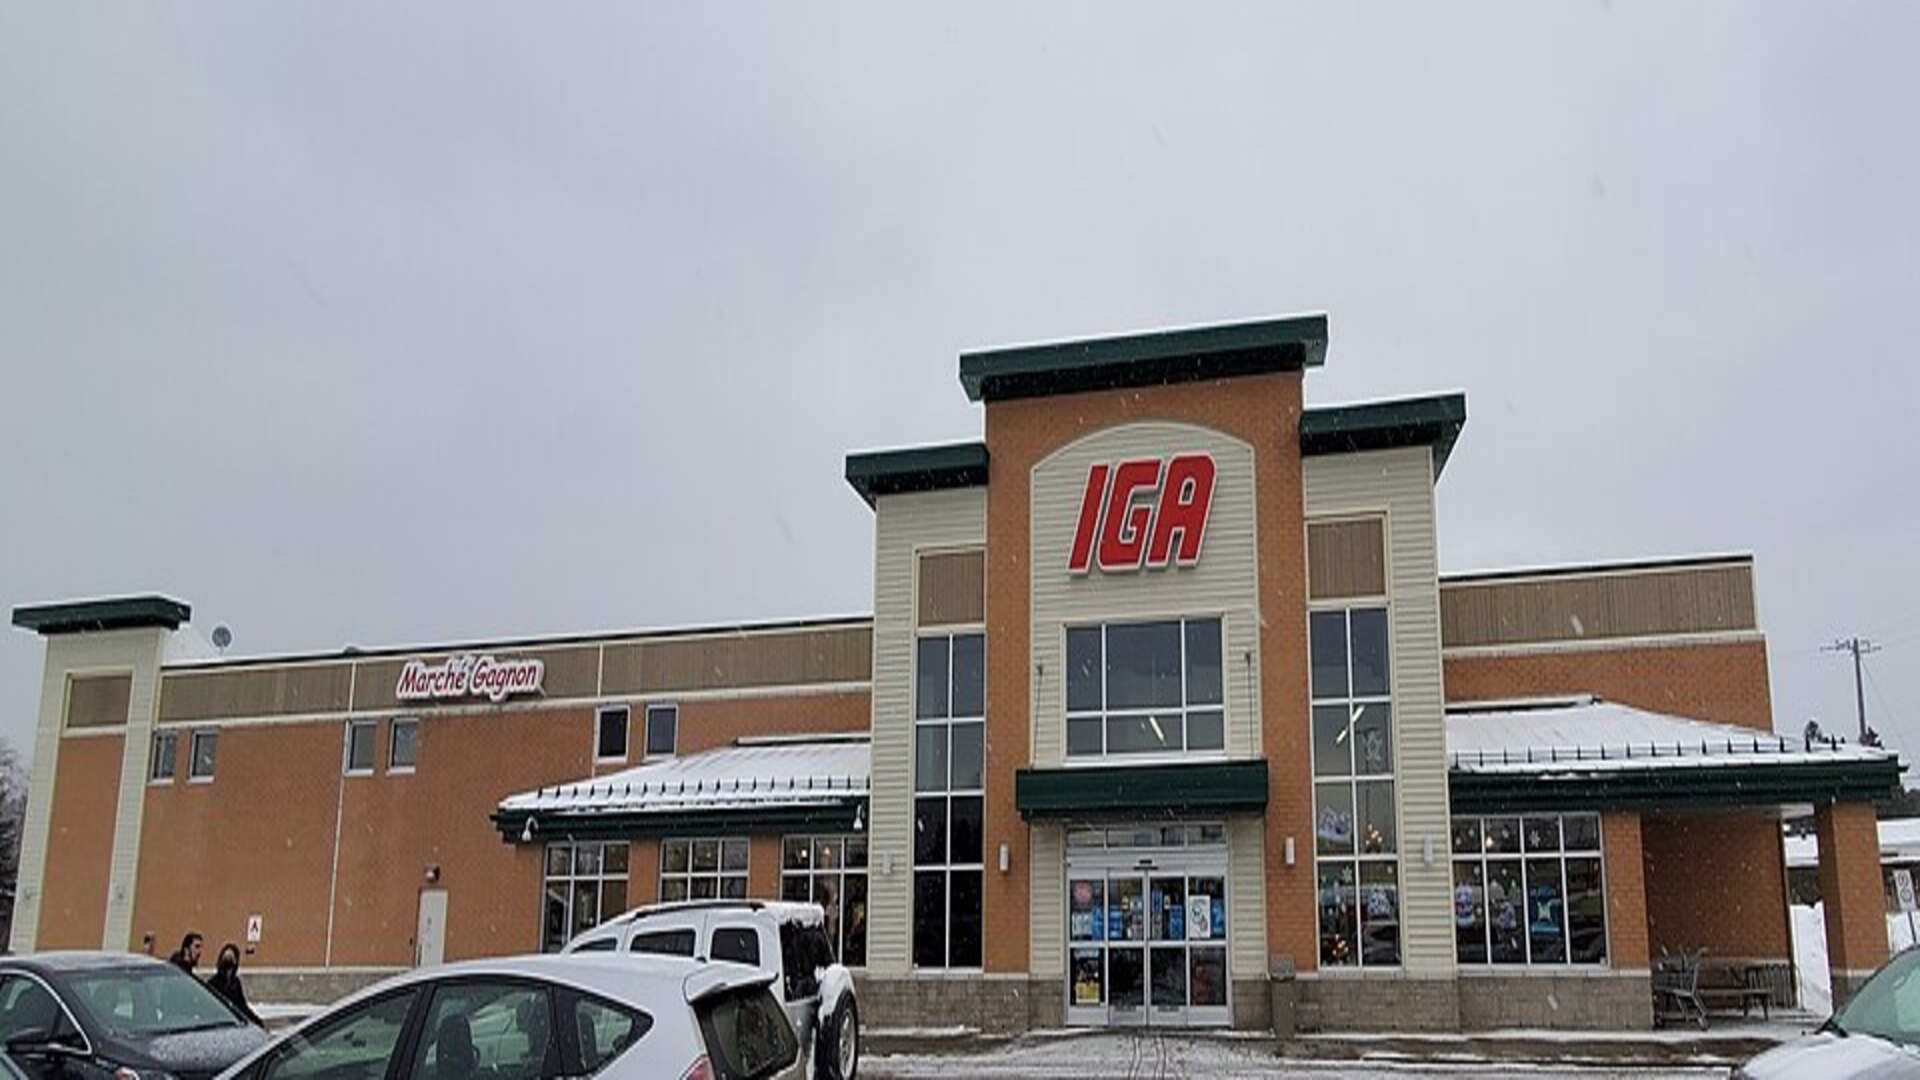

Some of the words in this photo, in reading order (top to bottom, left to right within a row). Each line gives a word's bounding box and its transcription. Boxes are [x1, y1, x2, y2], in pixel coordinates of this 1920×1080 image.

[1068, 454, 1216, 573] IGA
[398, 659, 467, 696] Marché
[471, 657, 540, 699] Gagnon
